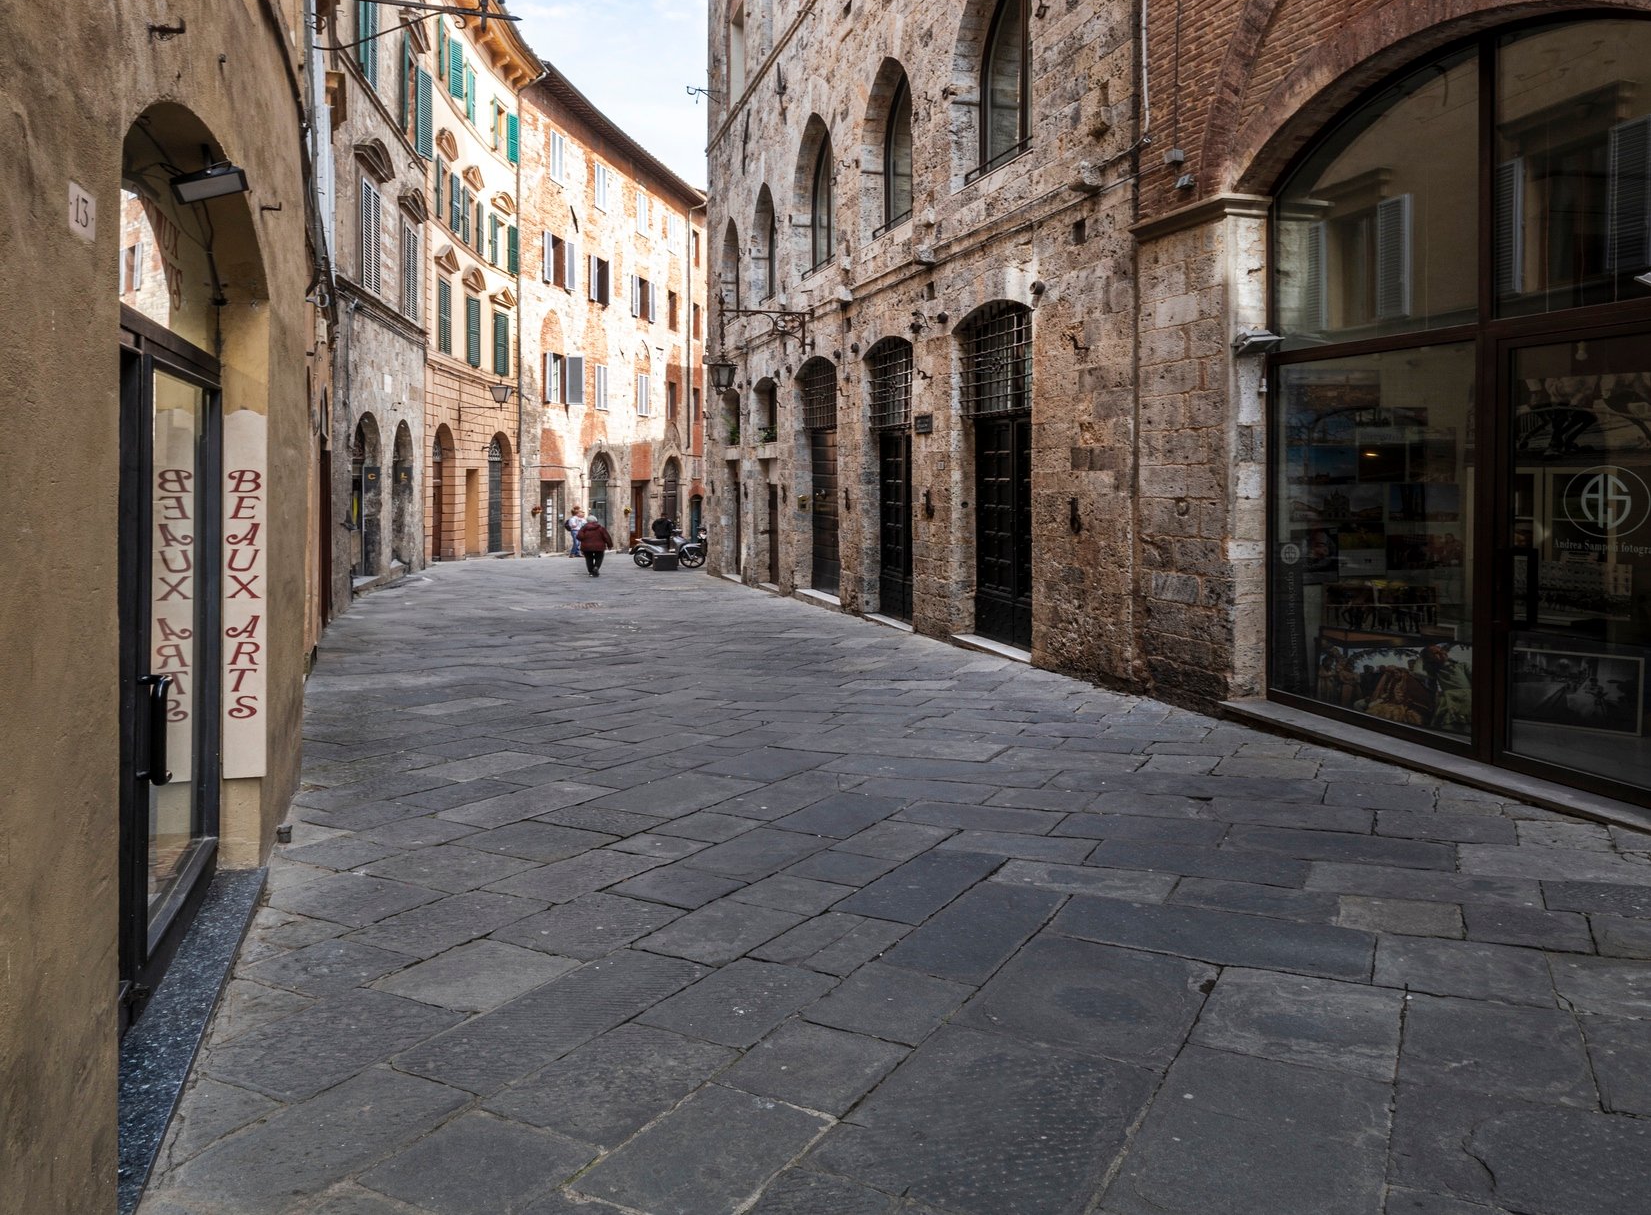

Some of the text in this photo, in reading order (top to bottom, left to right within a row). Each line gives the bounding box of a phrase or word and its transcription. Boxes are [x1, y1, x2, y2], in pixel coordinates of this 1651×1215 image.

[225, 469, 261, 719] BEAUX ARTS
[1553, 538, 1582, 550] Andrea
